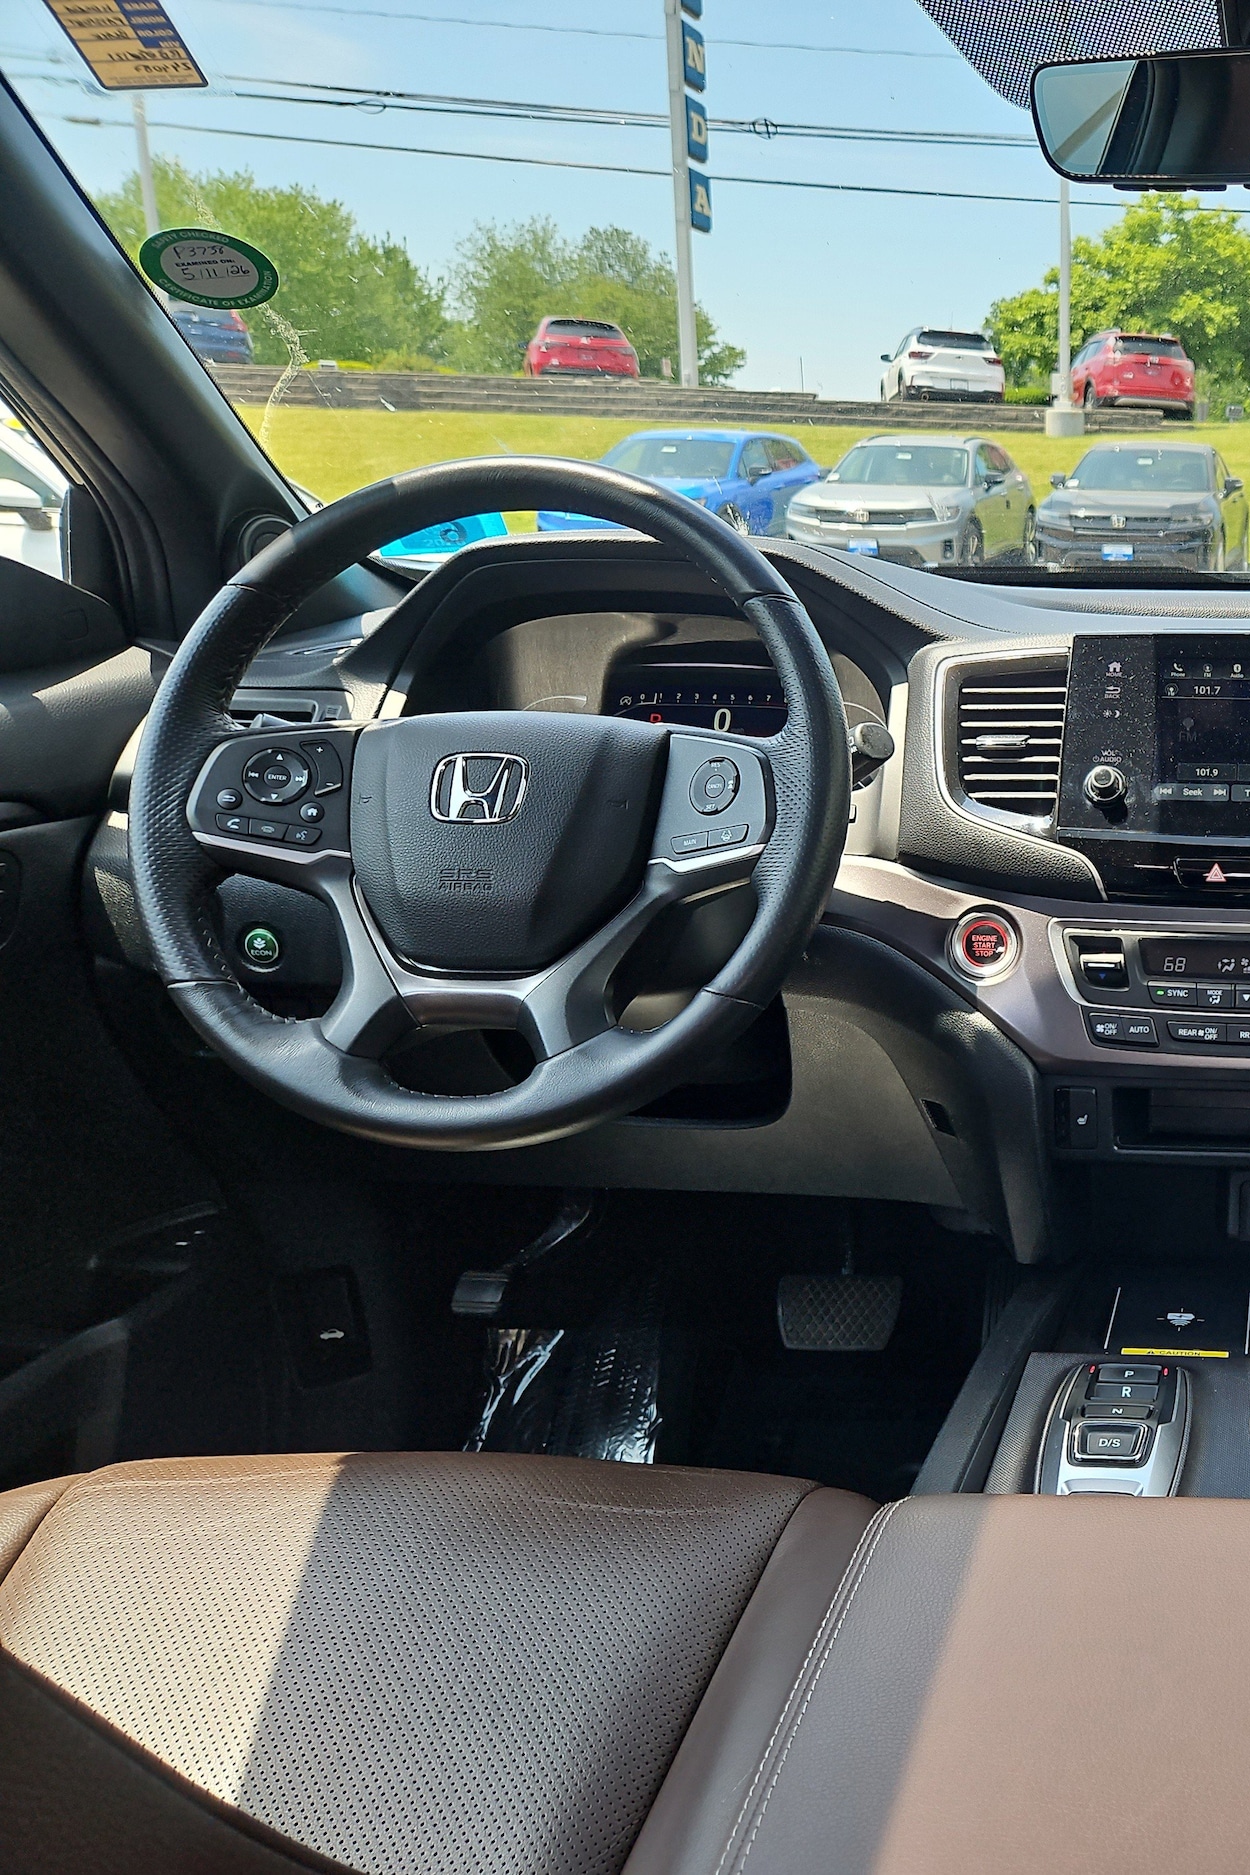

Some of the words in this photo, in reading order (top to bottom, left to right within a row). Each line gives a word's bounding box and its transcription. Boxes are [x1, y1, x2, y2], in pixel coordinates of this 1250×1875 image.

[180, 231, 230, 243] CHECKED
[174, 259, 219, 268] EXAMINED
[159, 278, 220, 307] CERTIFICATE
[222, 298, 236, 307] OF
[235, 270, 273, 306] EXAMINATION
[1193, 685, 1222, 695] 101.7
[713, 708, 732, 732] 0
[1101, 749, 1116, 757] VOL
[267, 773, 288, 781] ENTER
[1195, 768, 1219, 777] 101.9
[1183, 788, 1203, 796] Seek
[971, 934, 998, 942] ENGINE
[973, 941, 996, 949] START
[250, 949, 273, 957] ECON
[1163, 956, 1187, 973] 68
[1167, 989, 1189, 998] SYNC
[1128, 1025, 1150, 1034] AUTO
[1178, 1028, 1198, 1036] REAR
[1239, 1030, 1250, 1039] RR
[1124, 1370, 1135, 1378] P
[1121, 1385, 1132, 1398] R
[1098, 1438, 1121, 1448] D/S
